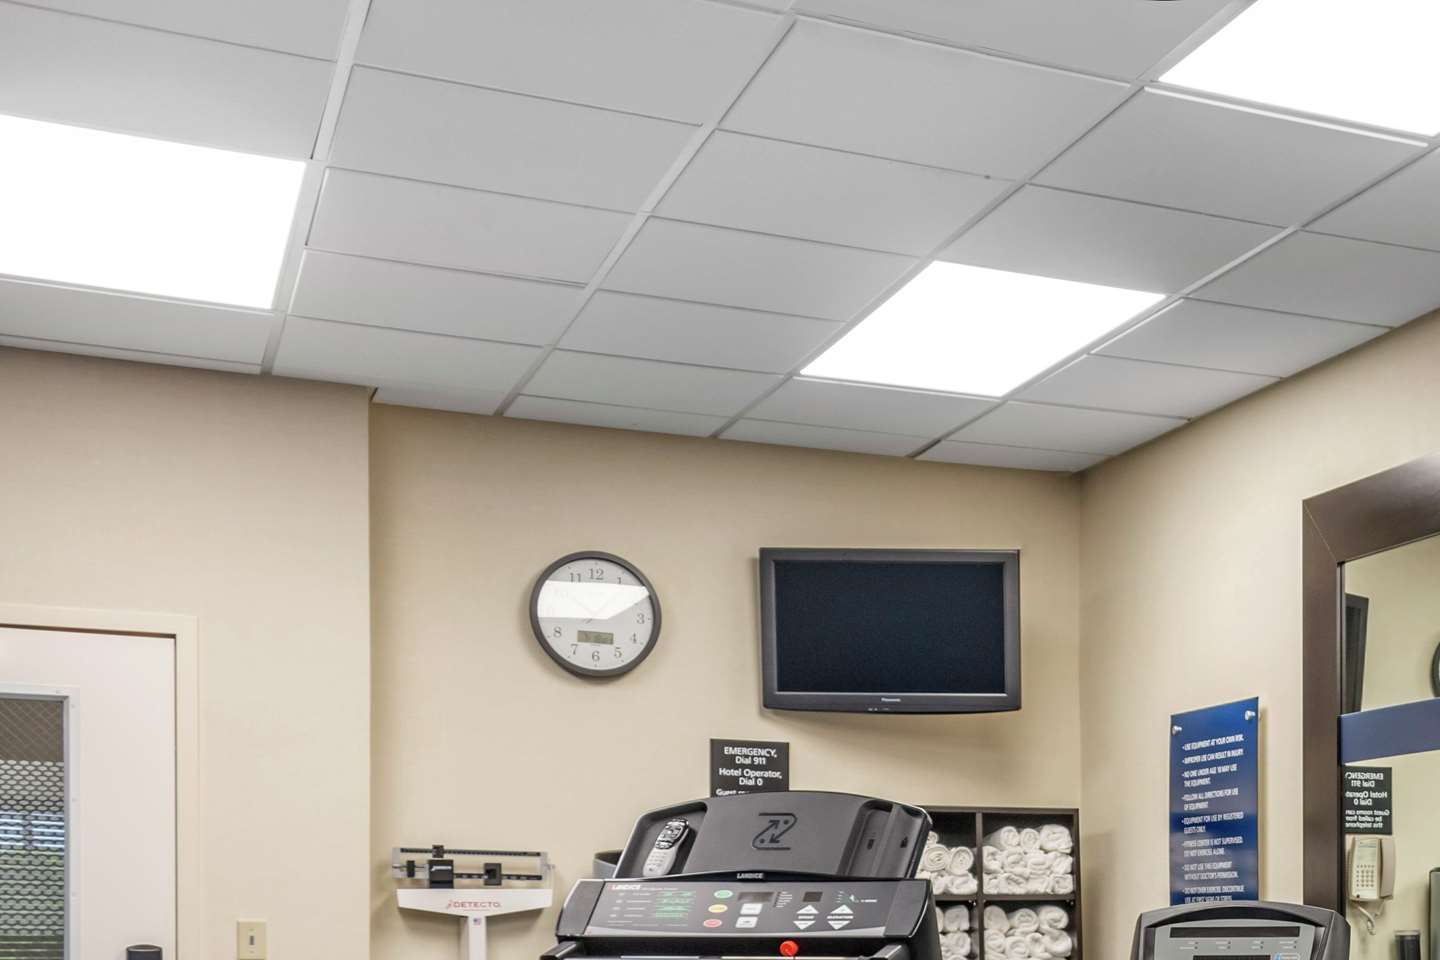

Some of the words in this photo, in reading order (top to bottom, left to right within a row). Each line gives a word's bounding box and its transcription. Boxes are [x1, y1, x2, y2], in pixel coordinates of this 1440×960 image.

[589, 568, 604, 581] 12
[636, 613, 645, 625] 3
[553, 626, 562, 638] 8
[630, 632, 637, 644] 4
[570, 643, 578, 655] 7
[614, 647, 622, 659] 5
[592, 650, 600, 661] 6
[735, 756, 752, 764] Dial
[753, 757, 766, 765] 911
[719, 768, 742, 776] Hotel
[743, 769, 783, 779] Operator,
[739, 777, 755, 785] Dial
